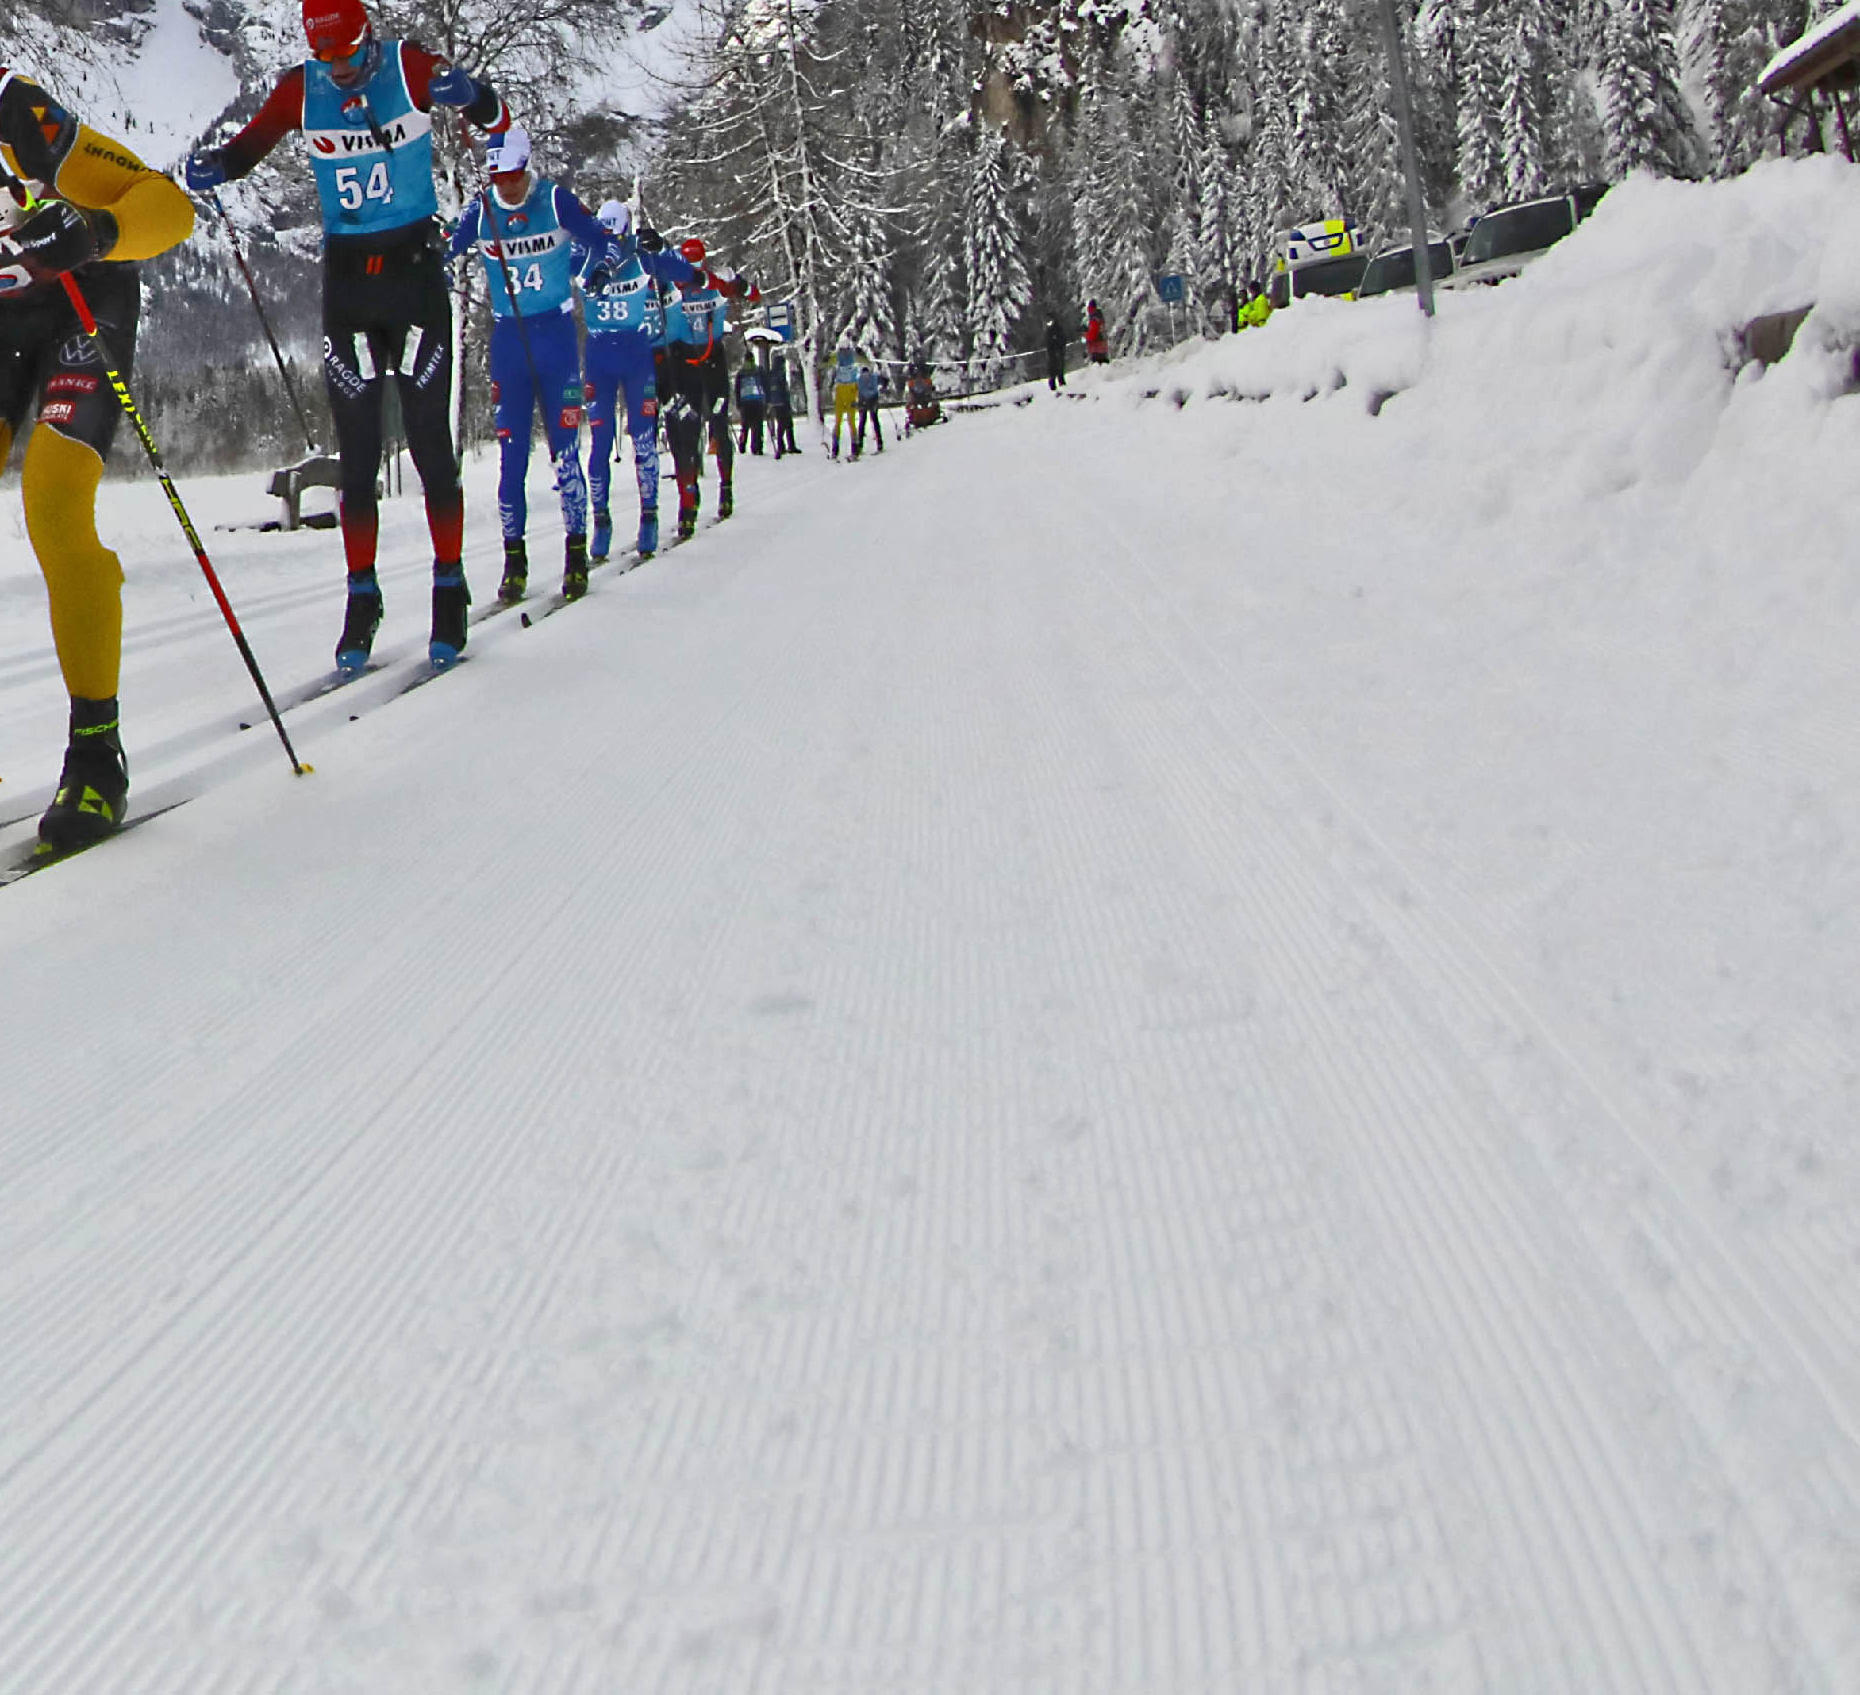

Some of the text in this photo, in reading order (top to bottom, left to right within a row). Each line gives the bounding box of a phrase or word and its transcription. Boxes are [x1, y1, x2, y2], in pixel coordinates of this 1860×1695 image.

[335, 161, 394, 210] 54
[506, 235, 556, 256] VISMA
[504, 262, 544, 296] 34
[596, 301, 629, 321] 38
[106, 370, 136, 413] LEKI
[329, 355, 368, 393] RAGDE
